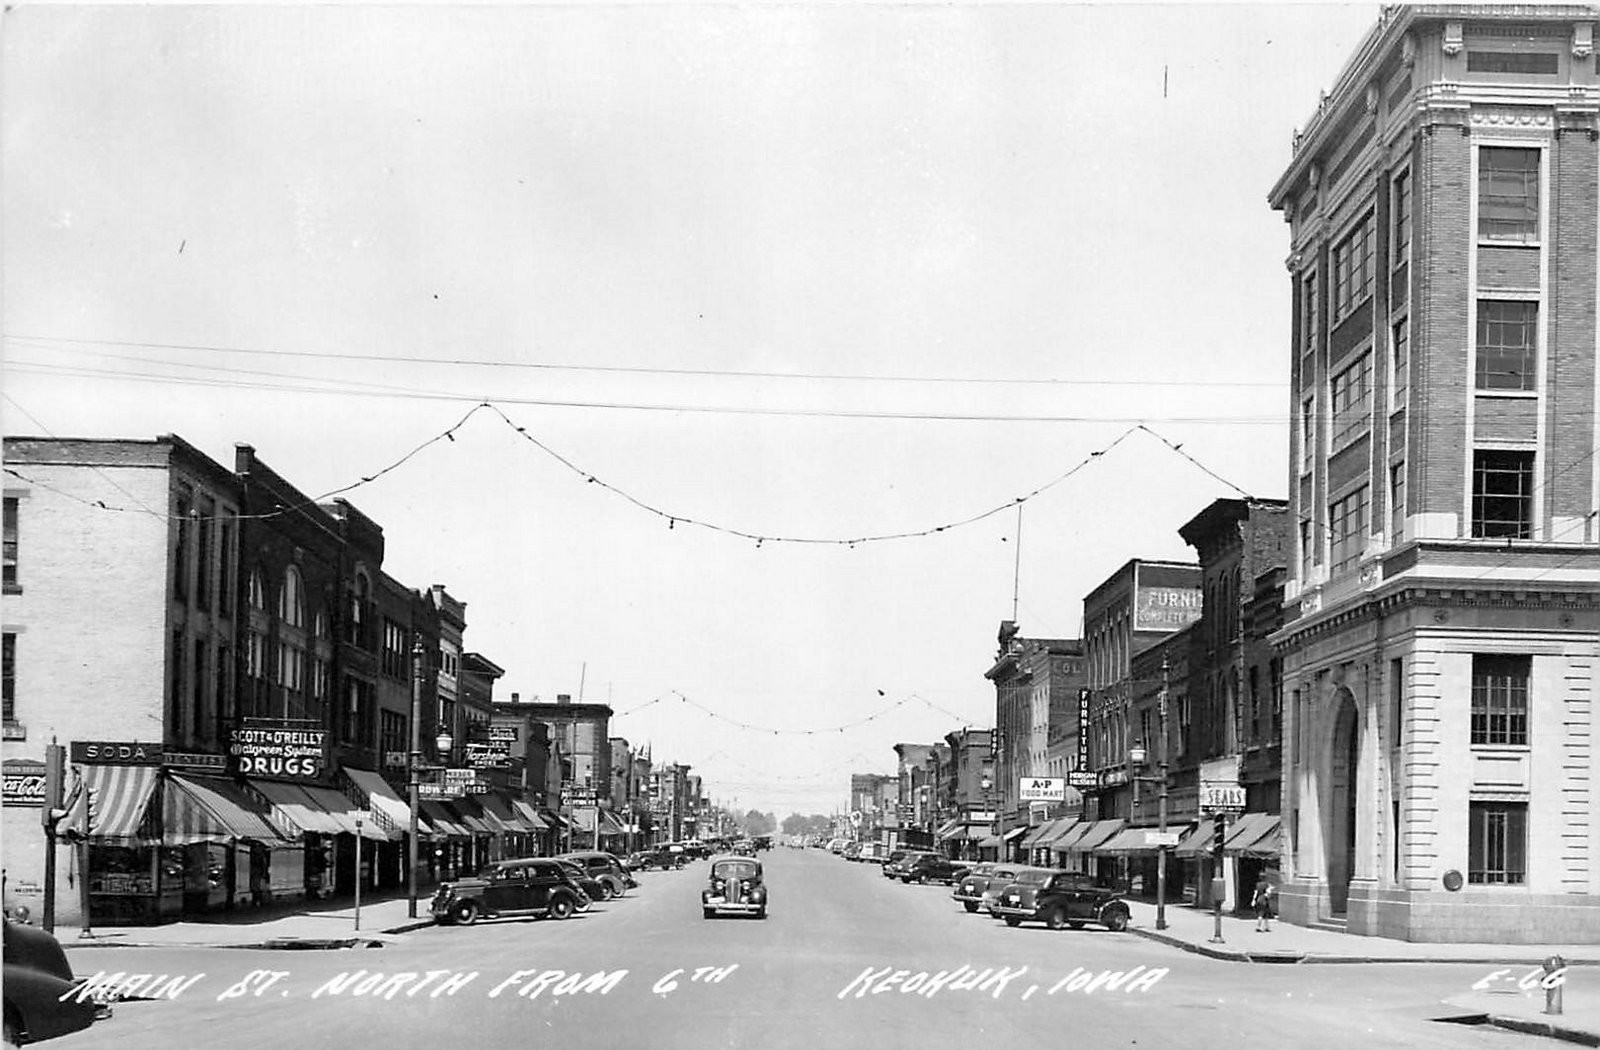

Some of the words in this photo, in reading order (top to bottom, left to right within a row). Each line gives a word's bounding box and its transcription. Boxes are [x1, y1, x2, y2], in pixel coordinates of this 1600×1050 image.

[231, 730, 266, 743] SCOTT
[273, 731, 324, 745] O'REILLY
[1080, 690, 1088, 771] FURNITURE
[86, 745, 147, 759] SODA
[239, 756, 315, 775] DRUGS
[1021, 789, 1041, 798] FOOD
[1043, 789, 1063, 798] MART
[1208, 789, 1242, 805] SEARS
